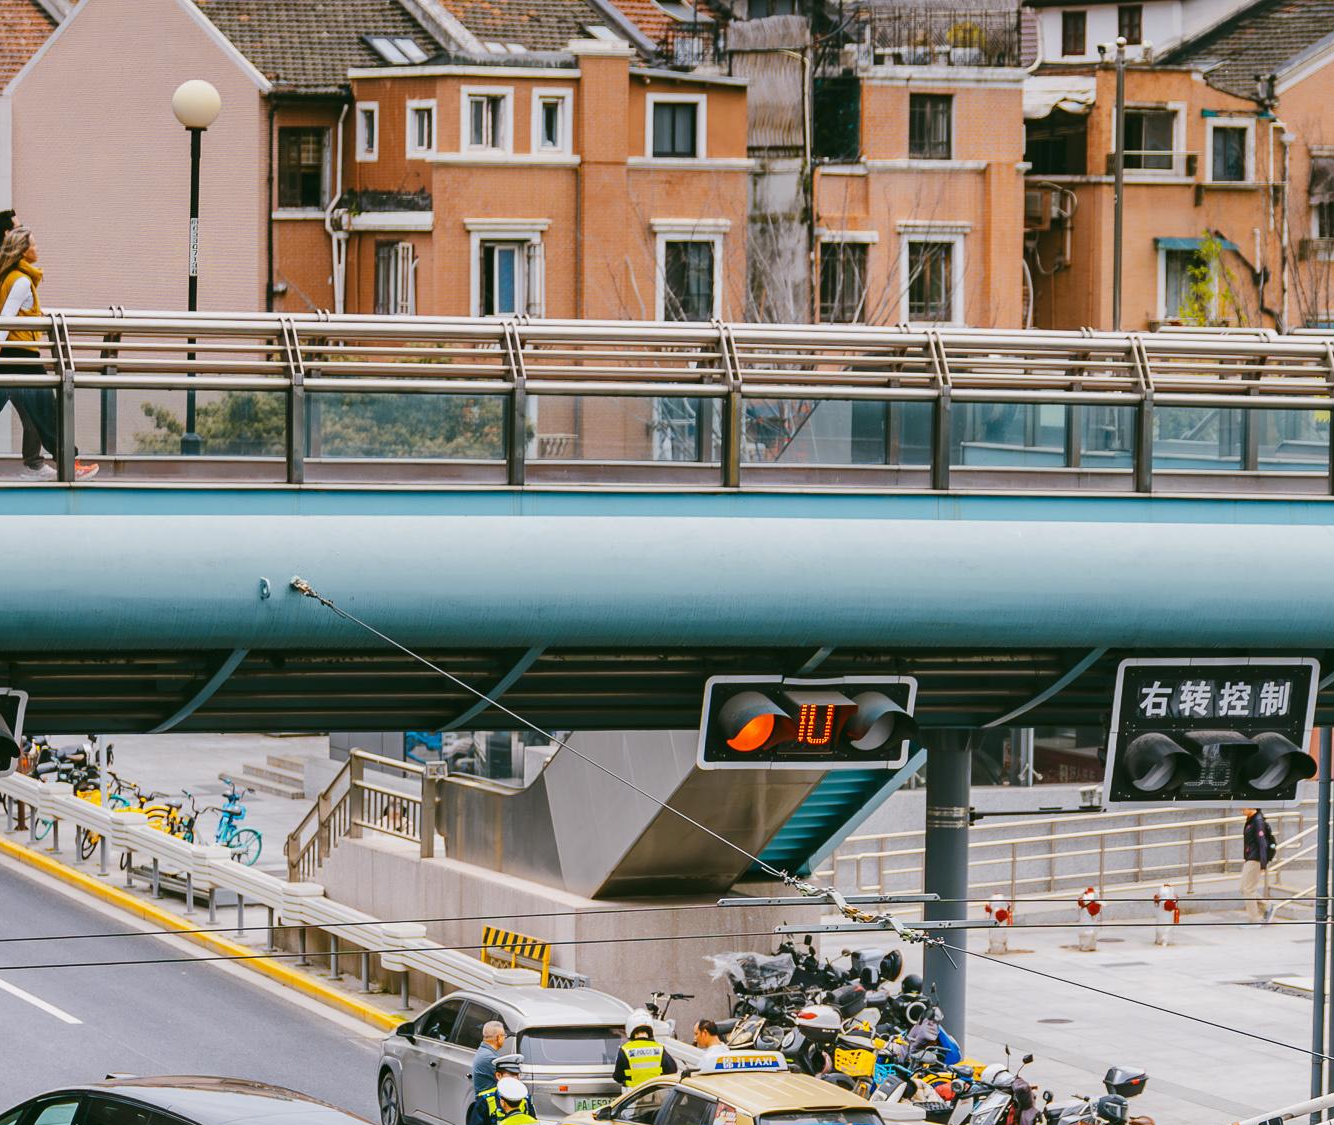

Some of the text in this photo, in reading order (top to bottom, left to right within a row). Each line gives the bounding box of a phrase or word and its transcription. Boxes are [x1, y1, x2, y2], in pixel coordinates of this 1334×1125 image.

[1139, 680, 1292, 718] 右转控制
[748, 1056, 773, 1067] TAXI
